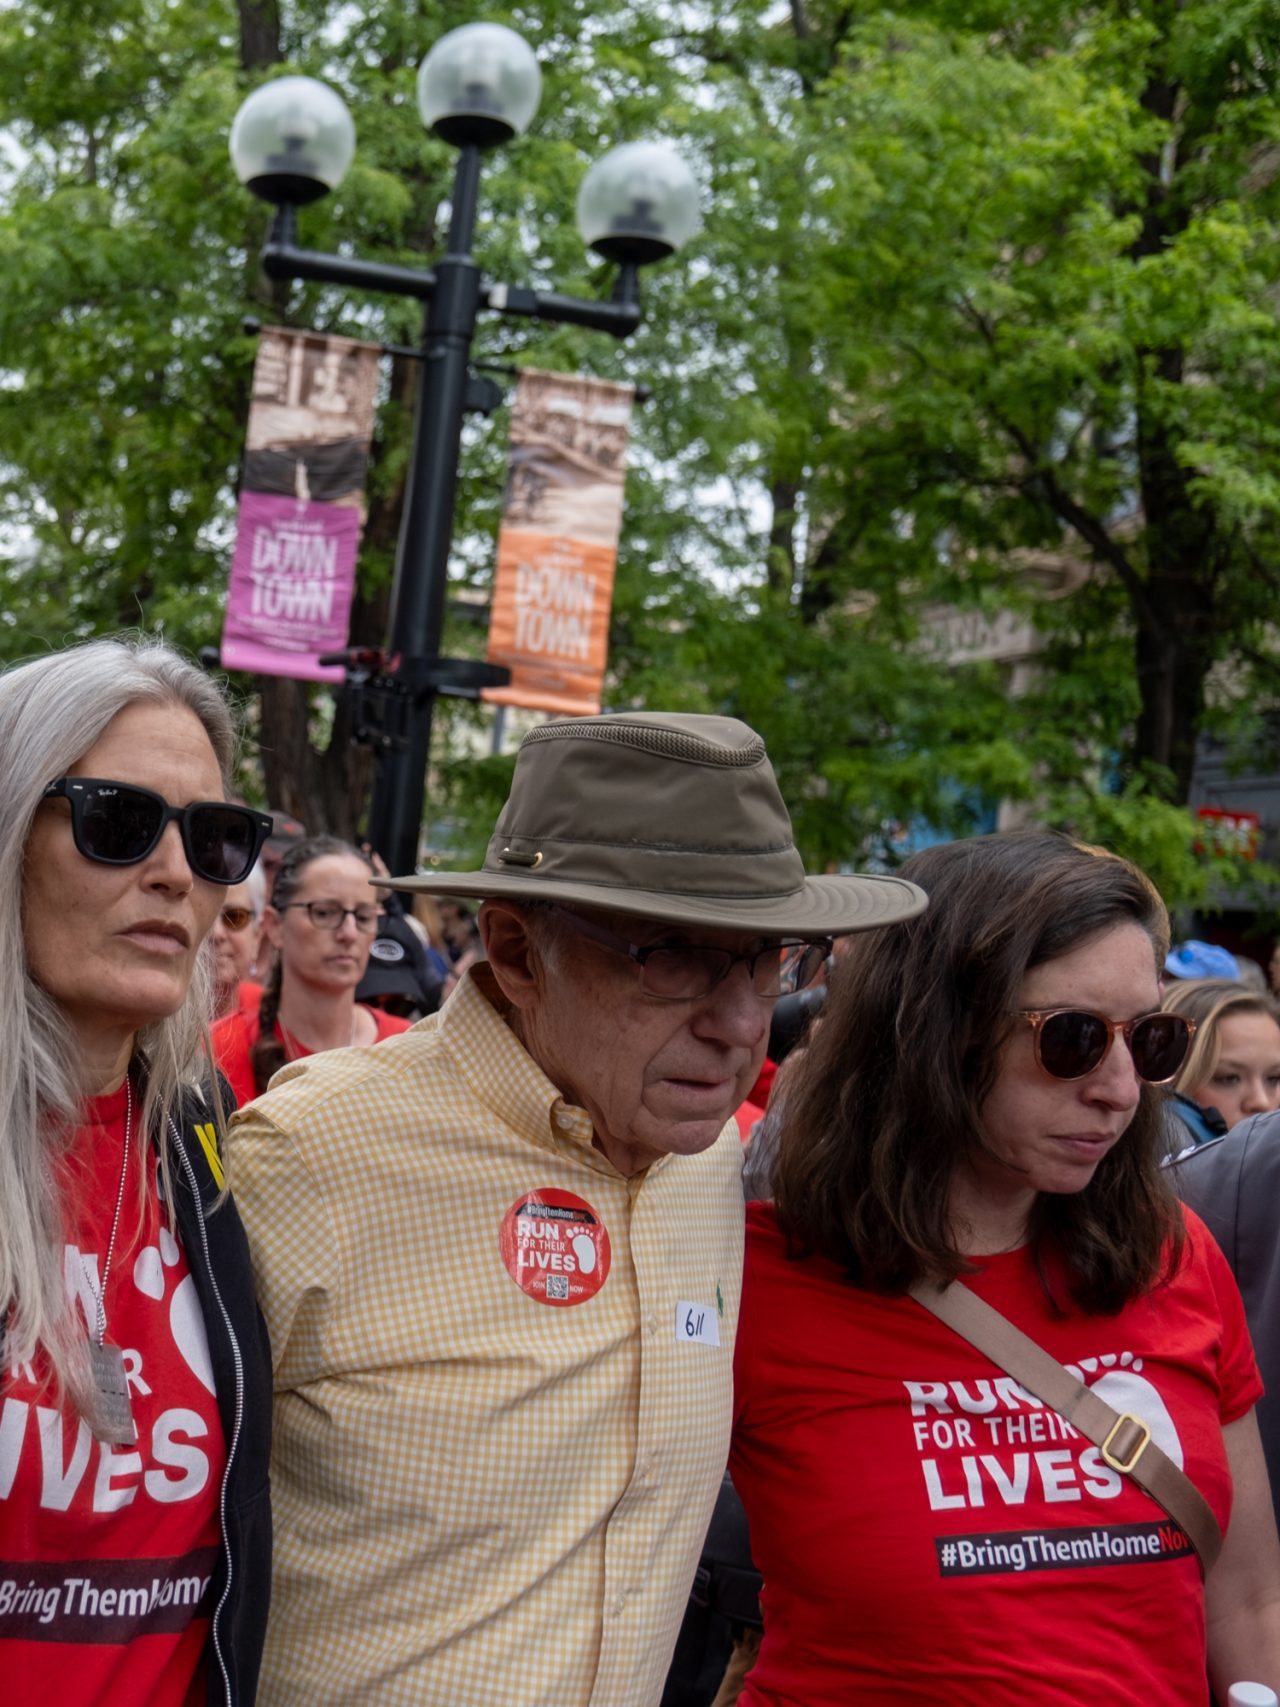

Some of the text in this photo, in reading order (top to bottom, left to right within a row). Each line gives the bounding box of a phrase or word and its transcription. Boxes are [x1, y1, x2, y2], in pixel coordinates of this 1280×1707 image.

[514, 562, 596, 615] DOWN
[515, 606, 592, 660] TOWN
[517, 1220, 559, 1241] RUN
[517, 1238, 566, 1252] FOR THEIR
[517, 1249, 576, 1272] LIVES
[685, 1308, 705, 1337] 611
[903, 1377, 1044, 1416] RUN
[913, 1412, 1079, 1451] FOR THEIR
[921, 1448, 1123, 1512] LIVES
